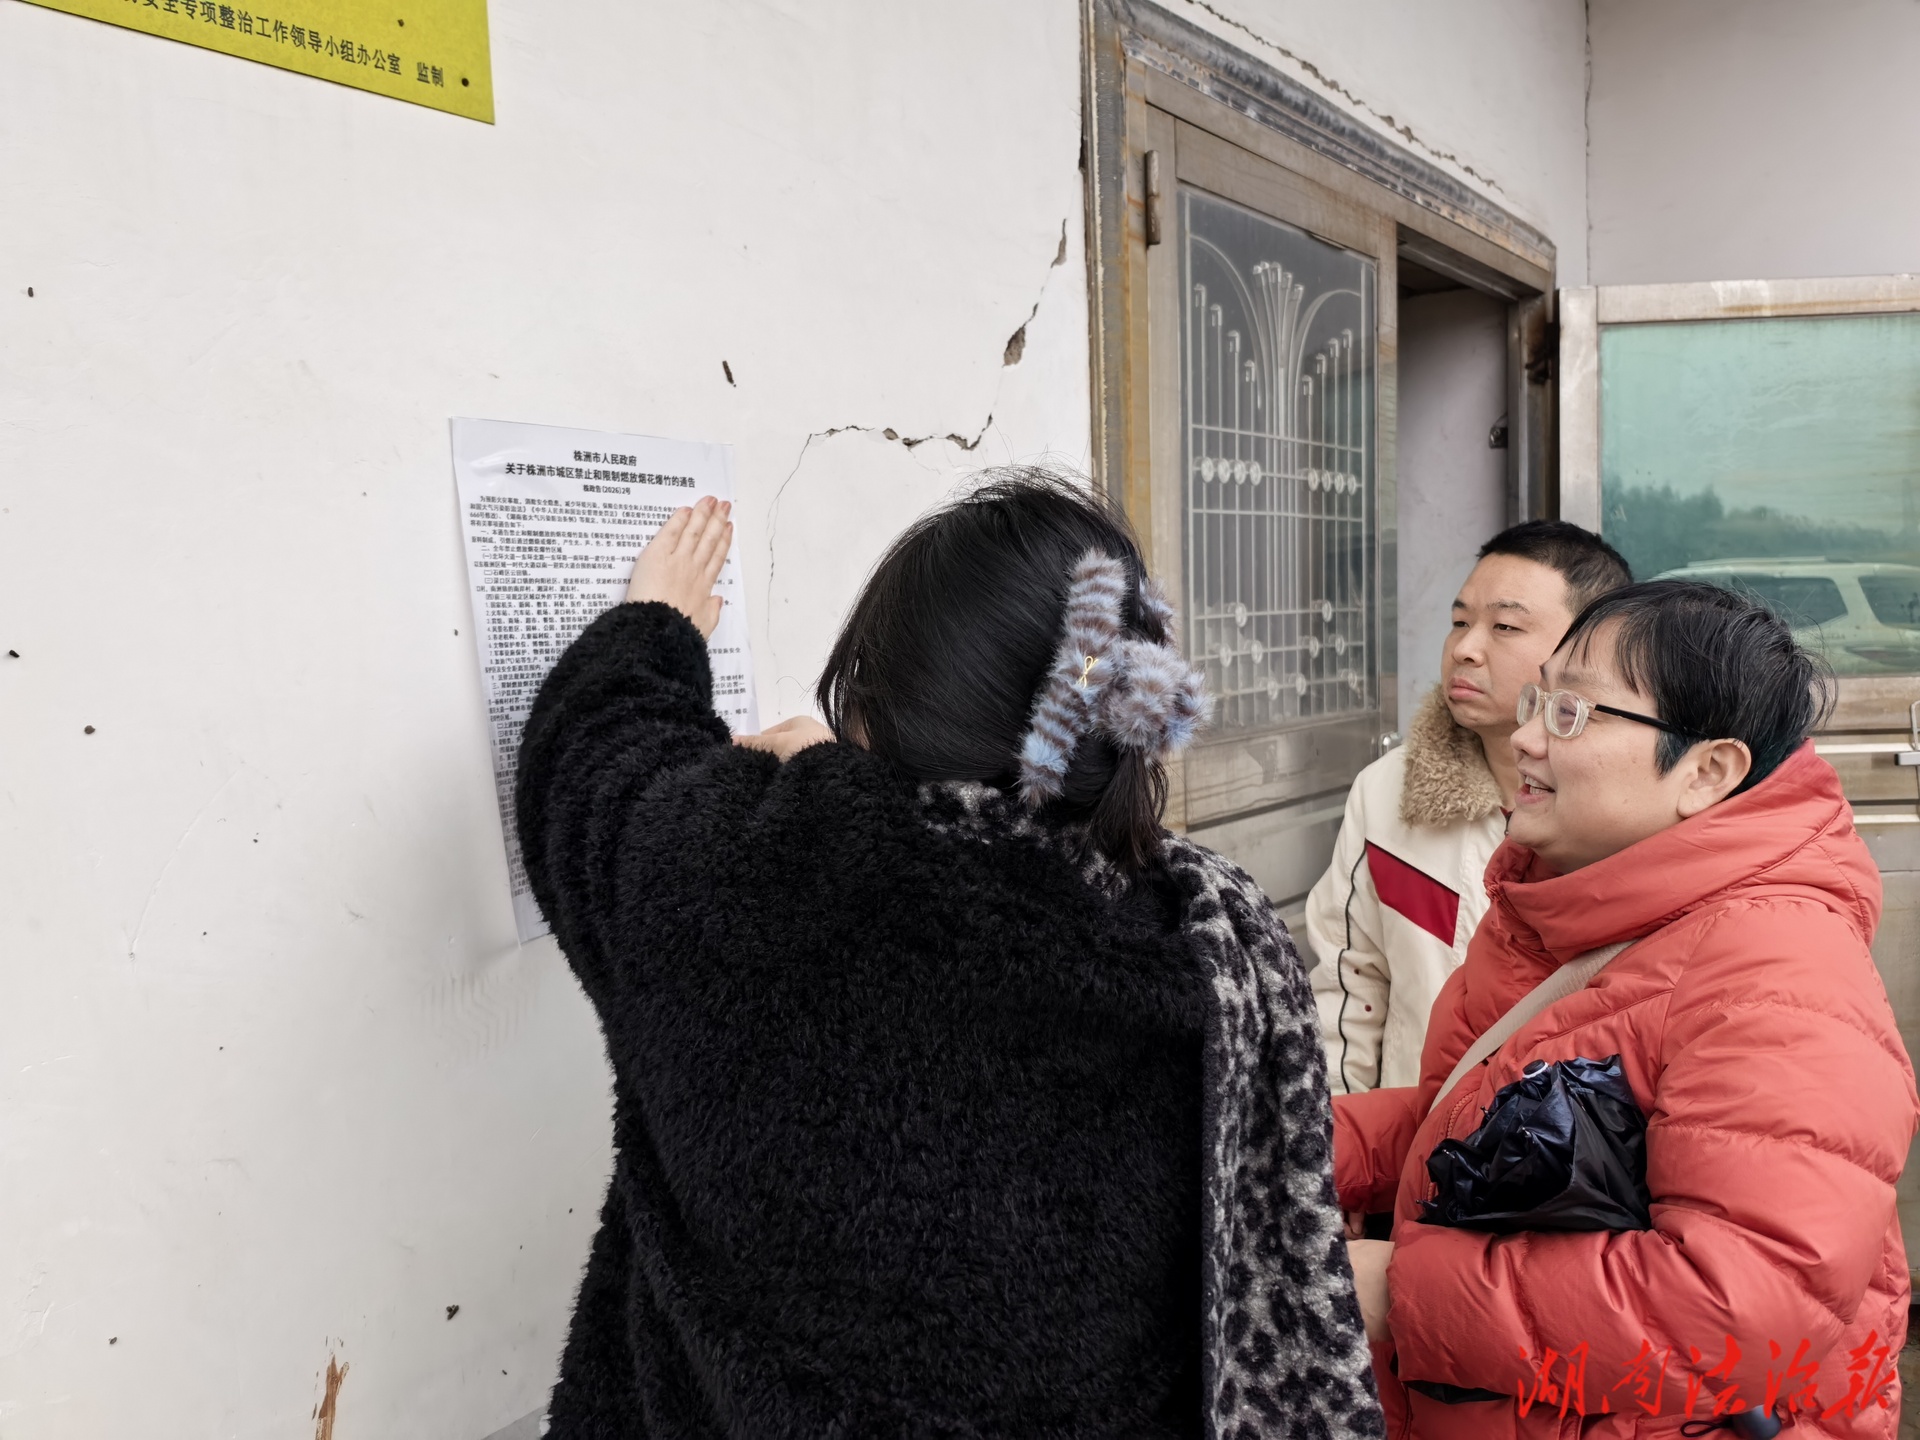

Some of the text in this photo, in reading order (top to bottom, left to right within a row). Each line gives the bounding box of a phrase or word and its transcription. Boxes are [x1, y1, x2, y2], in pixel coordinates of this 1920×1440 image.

[124, 0, 444, 87] 全专项整治工作领导小组办公室 监制
[573, 450, 637, 467] 株洲市人民政府
[505, 462, 696, 488] 关于株洲市城区禁止和限制燃放烟花爆竹的通告
